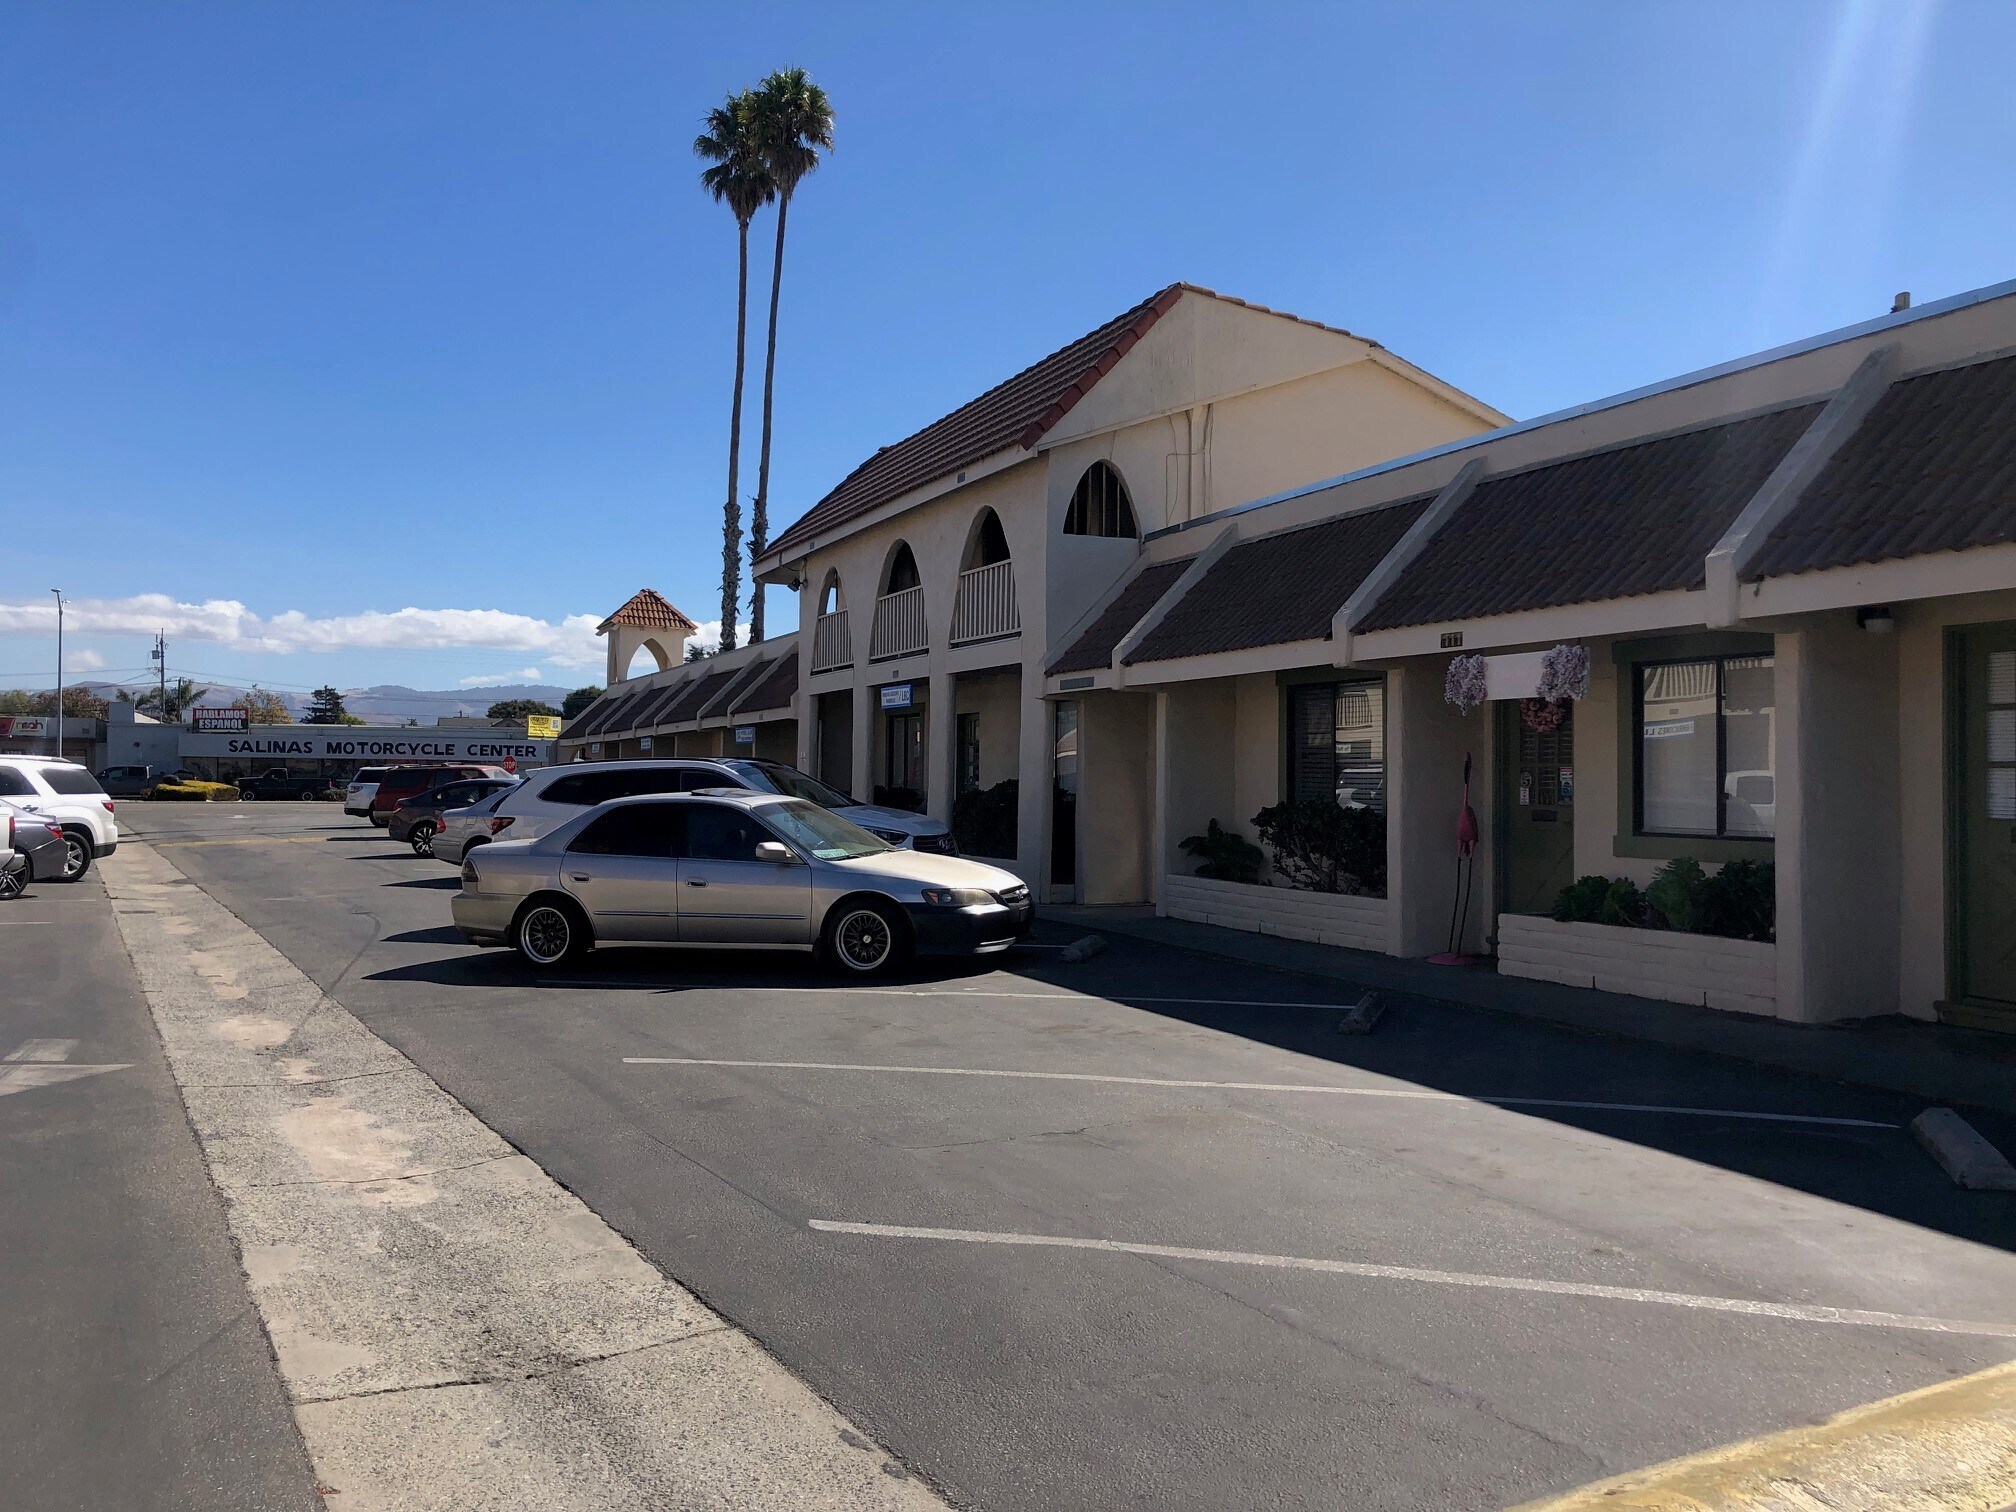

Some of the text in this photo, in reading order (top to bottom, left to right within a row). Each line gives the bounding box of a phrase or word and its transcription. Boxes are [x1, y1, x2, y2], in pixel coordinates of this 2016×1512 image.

[196, 709, 246, 719] HABLAMOS
[228, 739, 537, 758] SALINAS MOTORCYCLE CENTER
[502, 761, 516, 770] STOP
